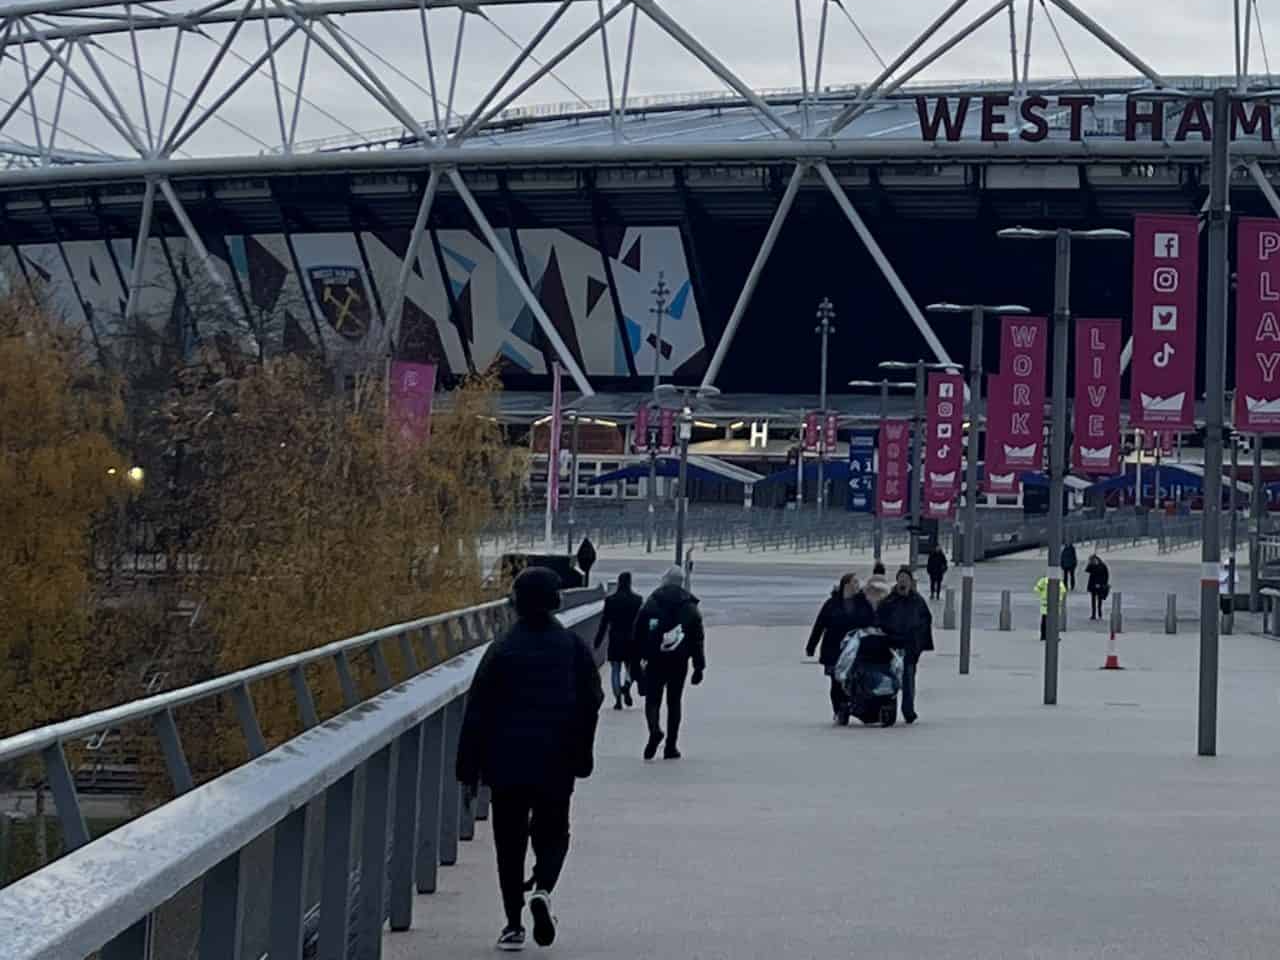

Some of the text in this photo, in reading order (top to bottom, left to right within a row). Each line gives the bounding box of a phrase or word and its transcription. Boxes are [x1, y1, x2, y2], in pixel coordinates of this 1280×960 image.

[915, 96, 1095, 141] WEST
[1125, 95, 1273, 141] HAM
[1010, 326, 1037, 435] WORK
[1087, 328, 1107, 436] LIVE
[750, 422, 768, 448] H
